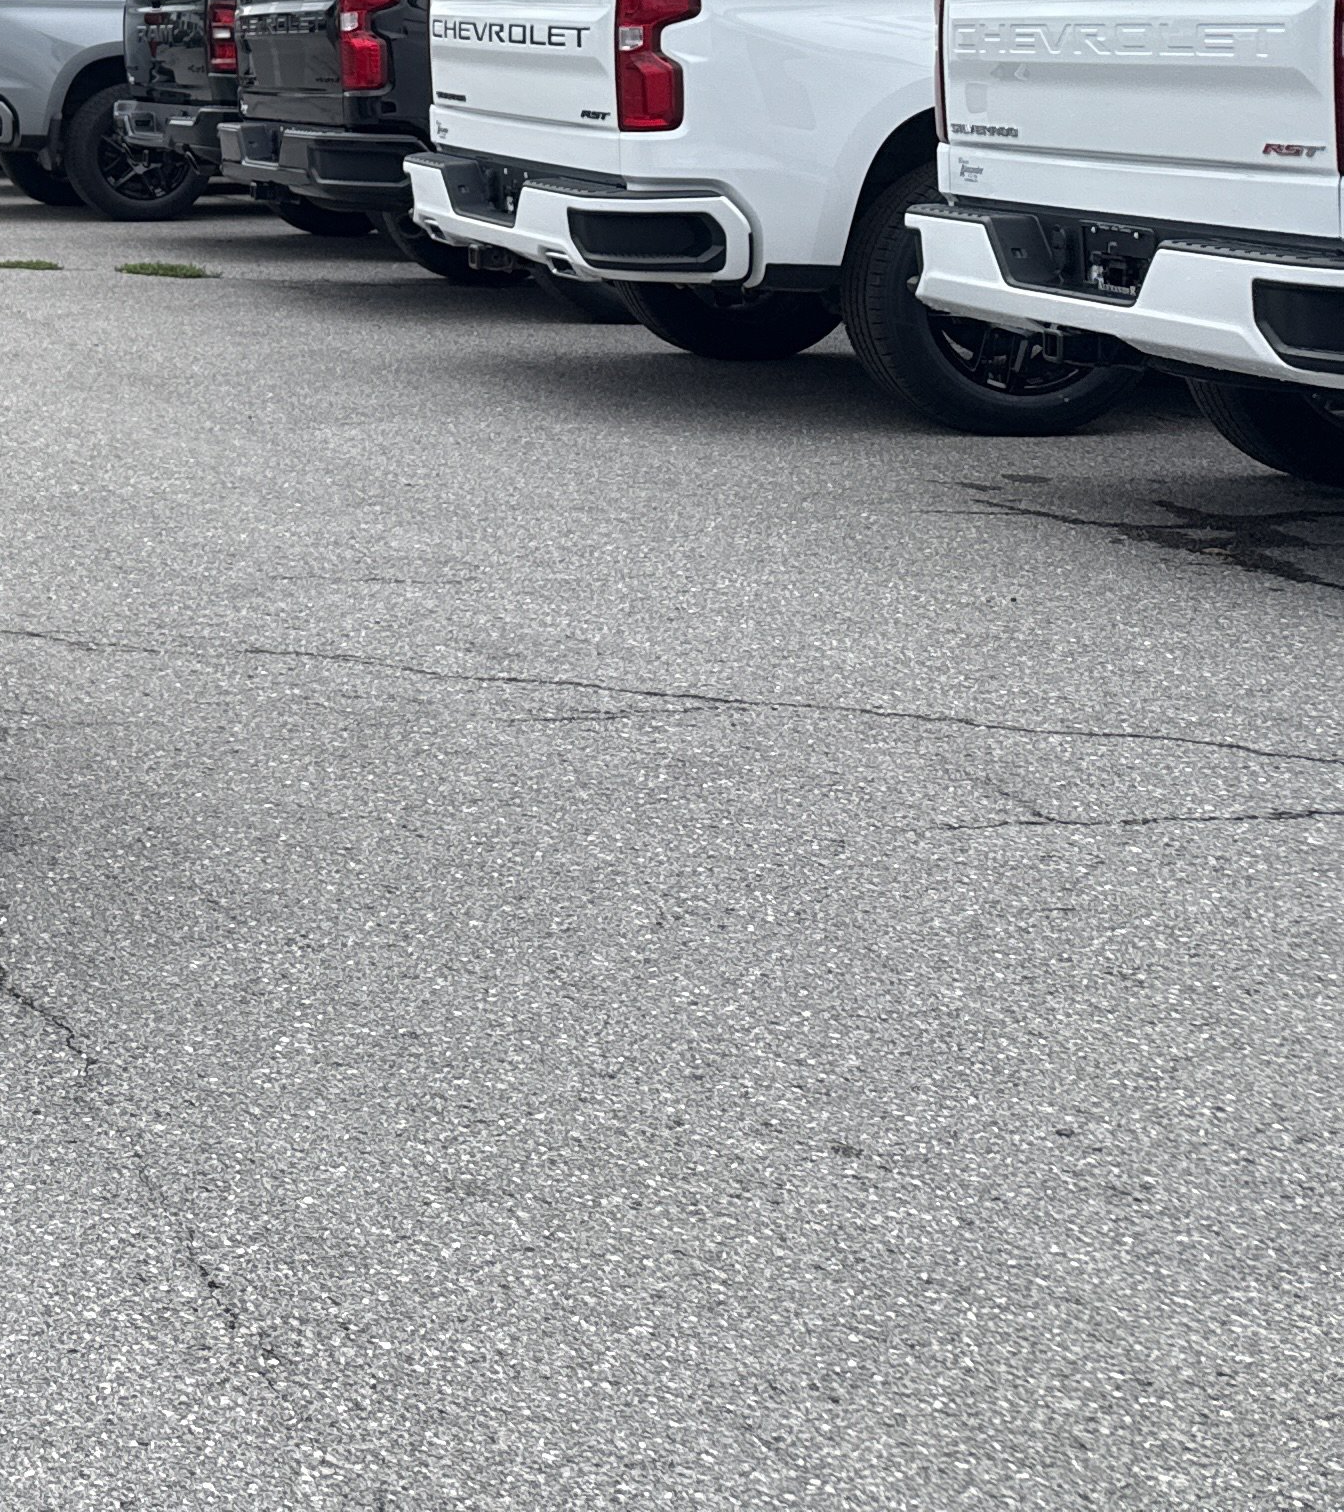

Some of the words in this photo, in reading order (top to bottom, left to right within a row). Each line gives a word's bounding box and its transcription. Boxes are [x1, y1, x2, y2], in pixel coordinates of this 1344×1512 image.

[432, 19, 591, 48] CHEVROLET
[953, 23, 1286, 58] CHEVROLET
[580, 109, 611, 121] RST
[1261, 142, 1326, 158] RST
